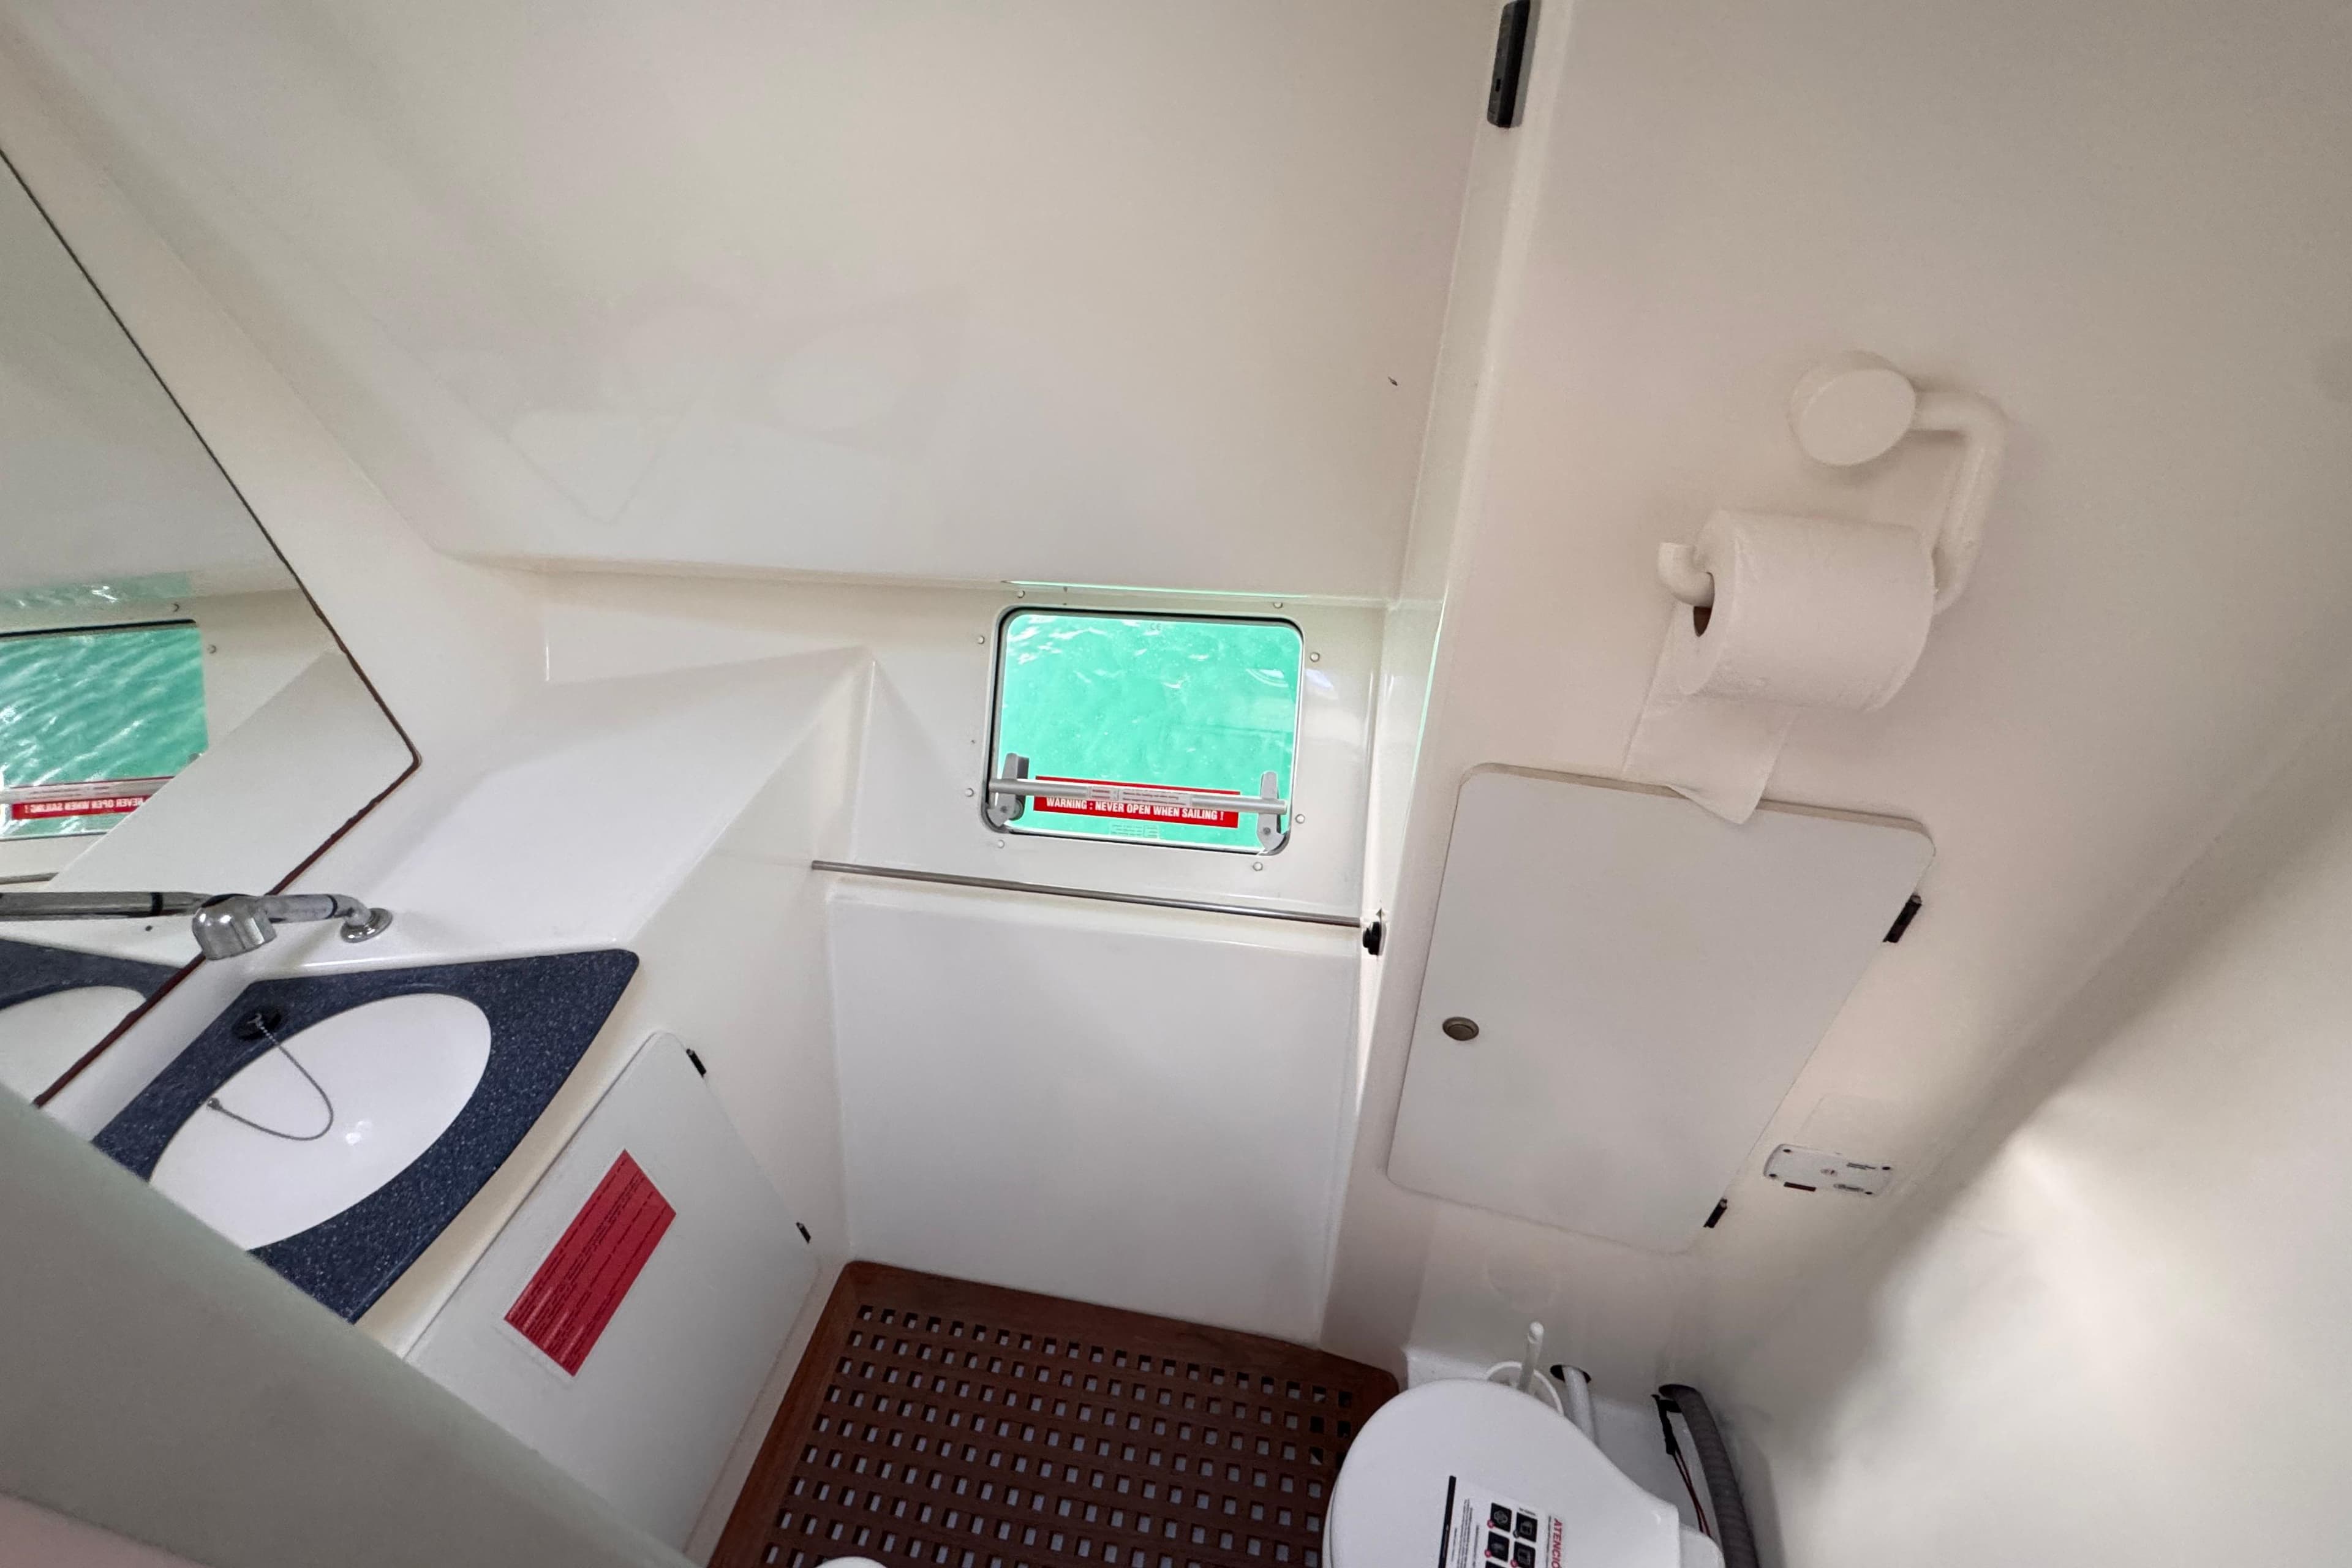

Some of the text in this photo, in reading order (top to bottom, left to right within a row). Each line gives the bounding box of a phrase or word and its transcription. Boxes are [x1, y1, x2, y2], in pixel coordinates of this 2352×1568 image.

[1046, 797, 1087, 809] WARNING
[1095, 801, 1125, 813] NEVER
[1126, 804, 1150, 815] OPEN
[1153, 806, 1180, 817] WHEN
[1182, 809, 1218, 820] SAILING
[1219, 811, 1224, 821] !
